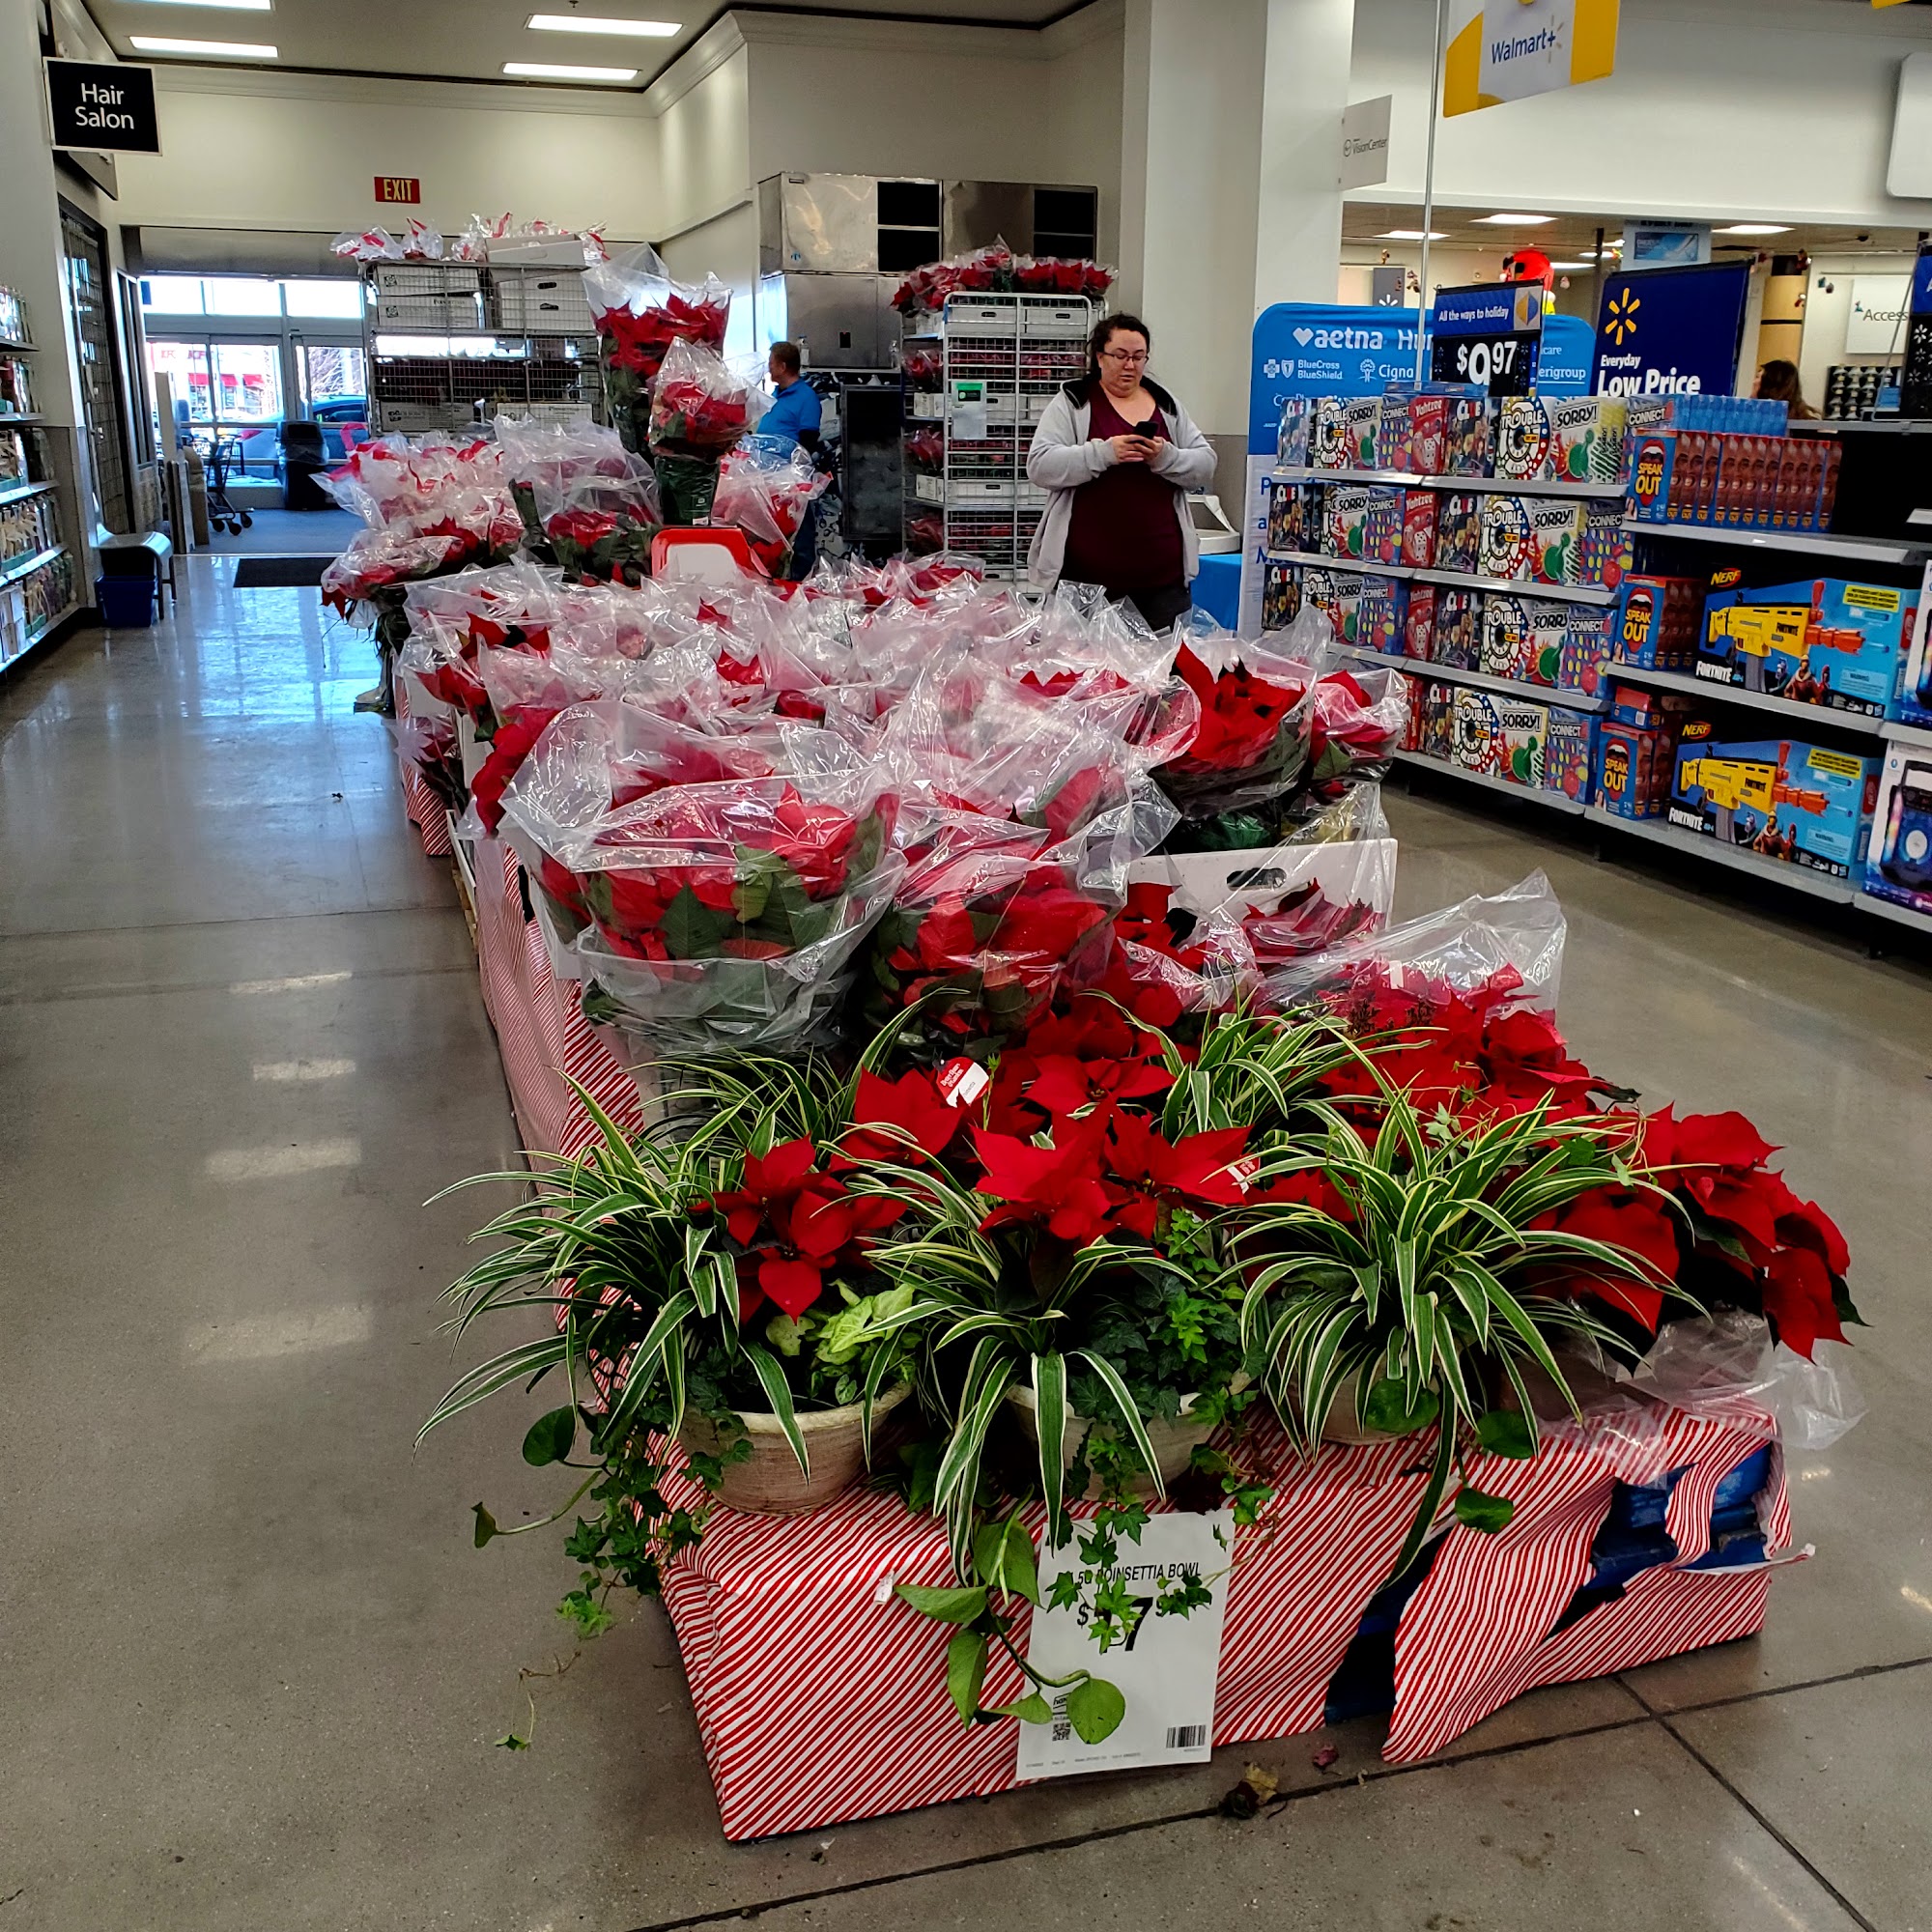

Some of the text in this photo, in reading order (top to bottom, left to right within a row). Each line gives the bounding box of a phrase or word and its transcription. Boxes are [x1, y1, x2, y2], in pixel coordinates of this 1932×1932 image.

[81, 82, 125, 105] Hair
[74, 105, 134, 129] Salon
[384, 179, 412, 202] EXIT
[1438, 305, 1510, 324] All the ways to holiday
[1314, 327, 1383, 350] aetna
[1297, 358, 1341, 370] BlueCross
[1600, 354, 1641, 370] Everyday
[1297, 369, 1344, 381] BlueShield
[1378, 364, 1414, 382] Cigna
[1597, 366, 1701, 398] Low Price
[1414, 399, 1442, 418] Yahtzee
[1456, 399, 1483, 421] CLUE
[1556, 402, 1598, 428] SORRY!
[1628, 407, 1665, 427] CONNECT
[1500, 409, 1544, 432] TROUBLE
[1637, 463, 1663, 475] SPEAK
[1634, 476, 1662, 497] OUT
[1370, 498, 1397, 512] CONNECT
[1406, 493, 1434, 511] Yahtzee
[1449, 495, 1474, 516] CLUE
[1483, 510, 1523, 527] TROUBLE
[1534, 509, 1576, 531] SORRY!
[1710, 568, 1741, 585] NERF
[1363, 588, 1389, 599] CONNECT
[1446, 590, 1470, 611] CLUE
[1484, 610, 1523, 626] TROUBLE
[1570, 619, 1604, 633] CONNECT
[1625, 609, 1651, 624] SPEAK
[1623, 621, 1650, 643] OUT
[1695, 660, 1733, 683] FORTNITE
[1429, 683, 1452, 704] CLUE
[1454, 706, 1493, 723] TROUBLE
[1501, 713, 1543, 731] SORRY!
[1550, 724, 1581, 738] CONNECT
[1682, 723, 1711, 737] NERF
[1605, 757, 1629, 776] SPEAK
[1604, 770, 1629, 793] OUT
[1668, 806, 1703, 832] FORTNITE
[1167, 1562, 1202, 1579] BOWL
